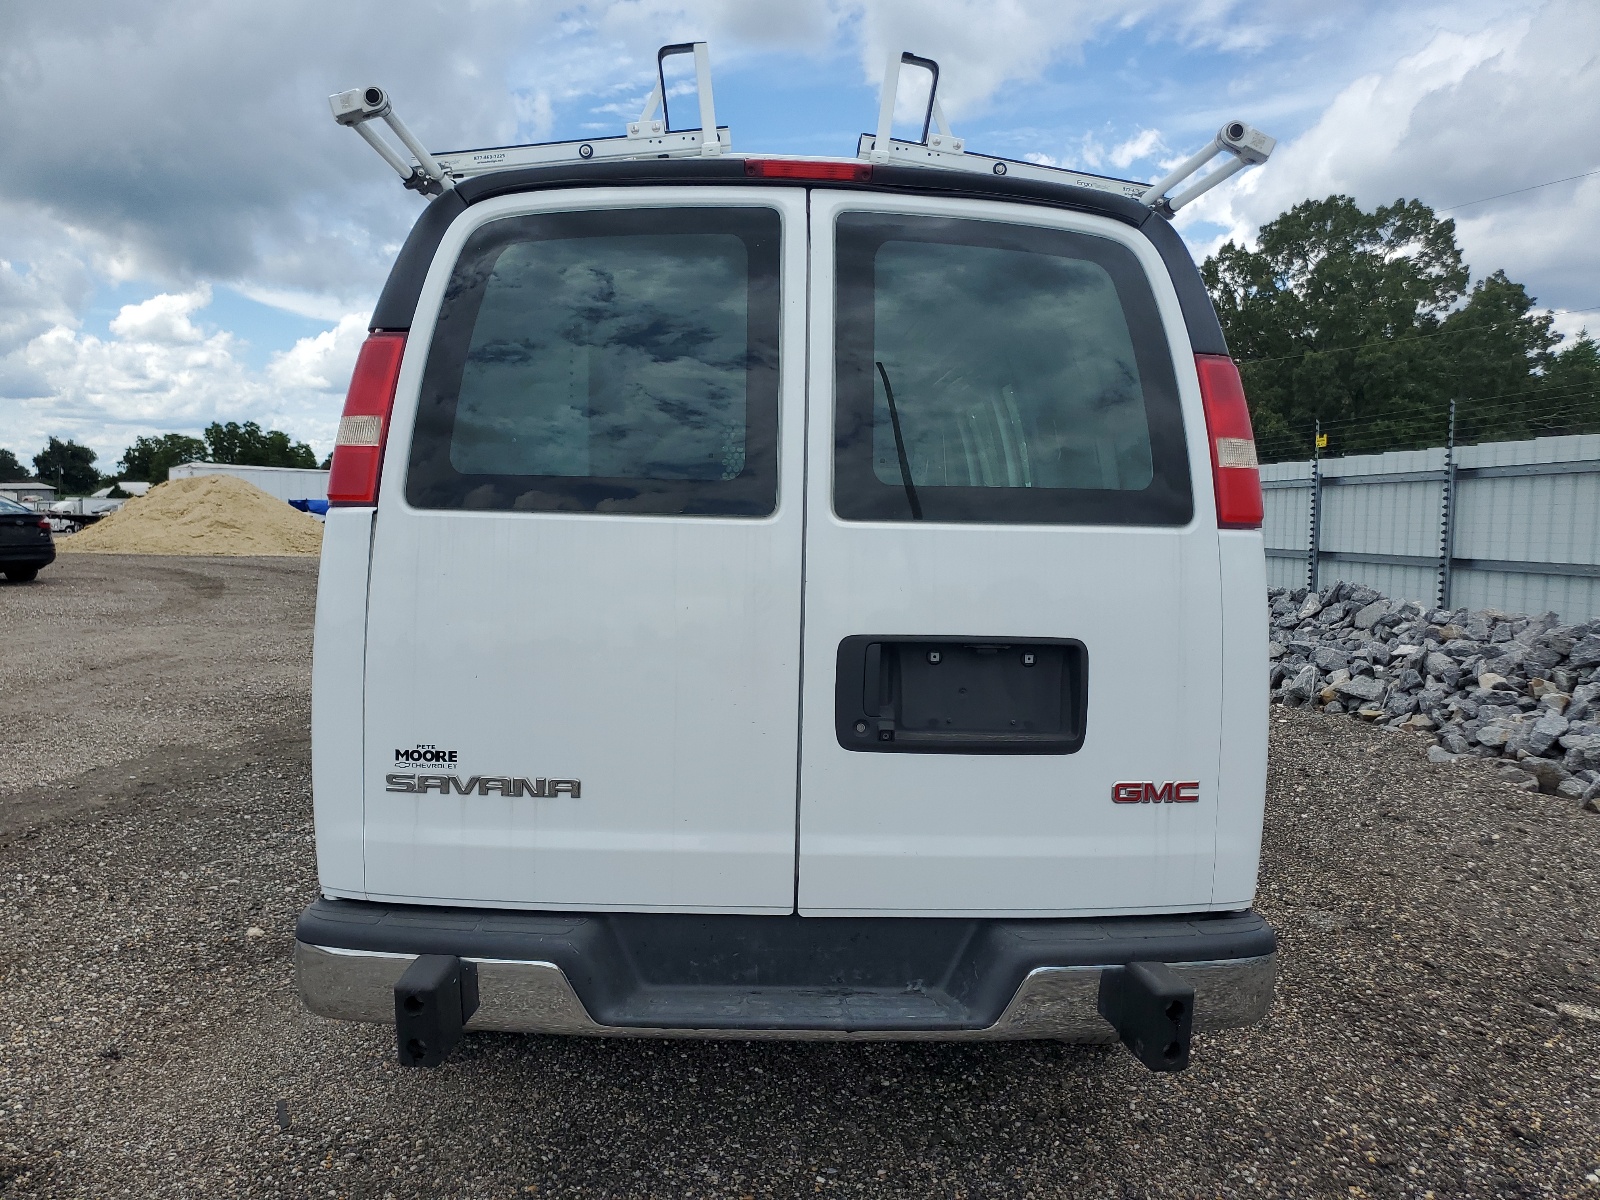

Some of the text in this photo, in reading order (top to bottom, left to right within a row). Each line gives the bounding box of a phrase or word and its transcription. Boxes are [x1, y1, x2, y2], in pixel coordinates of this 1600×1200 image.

[395, 749, 458, 763] MOORE
[411, 762, 458, 770] CHEVROLET
[386, 772, 581, 798] SAVANA
[1111, 780, 1200, 803] GMC
